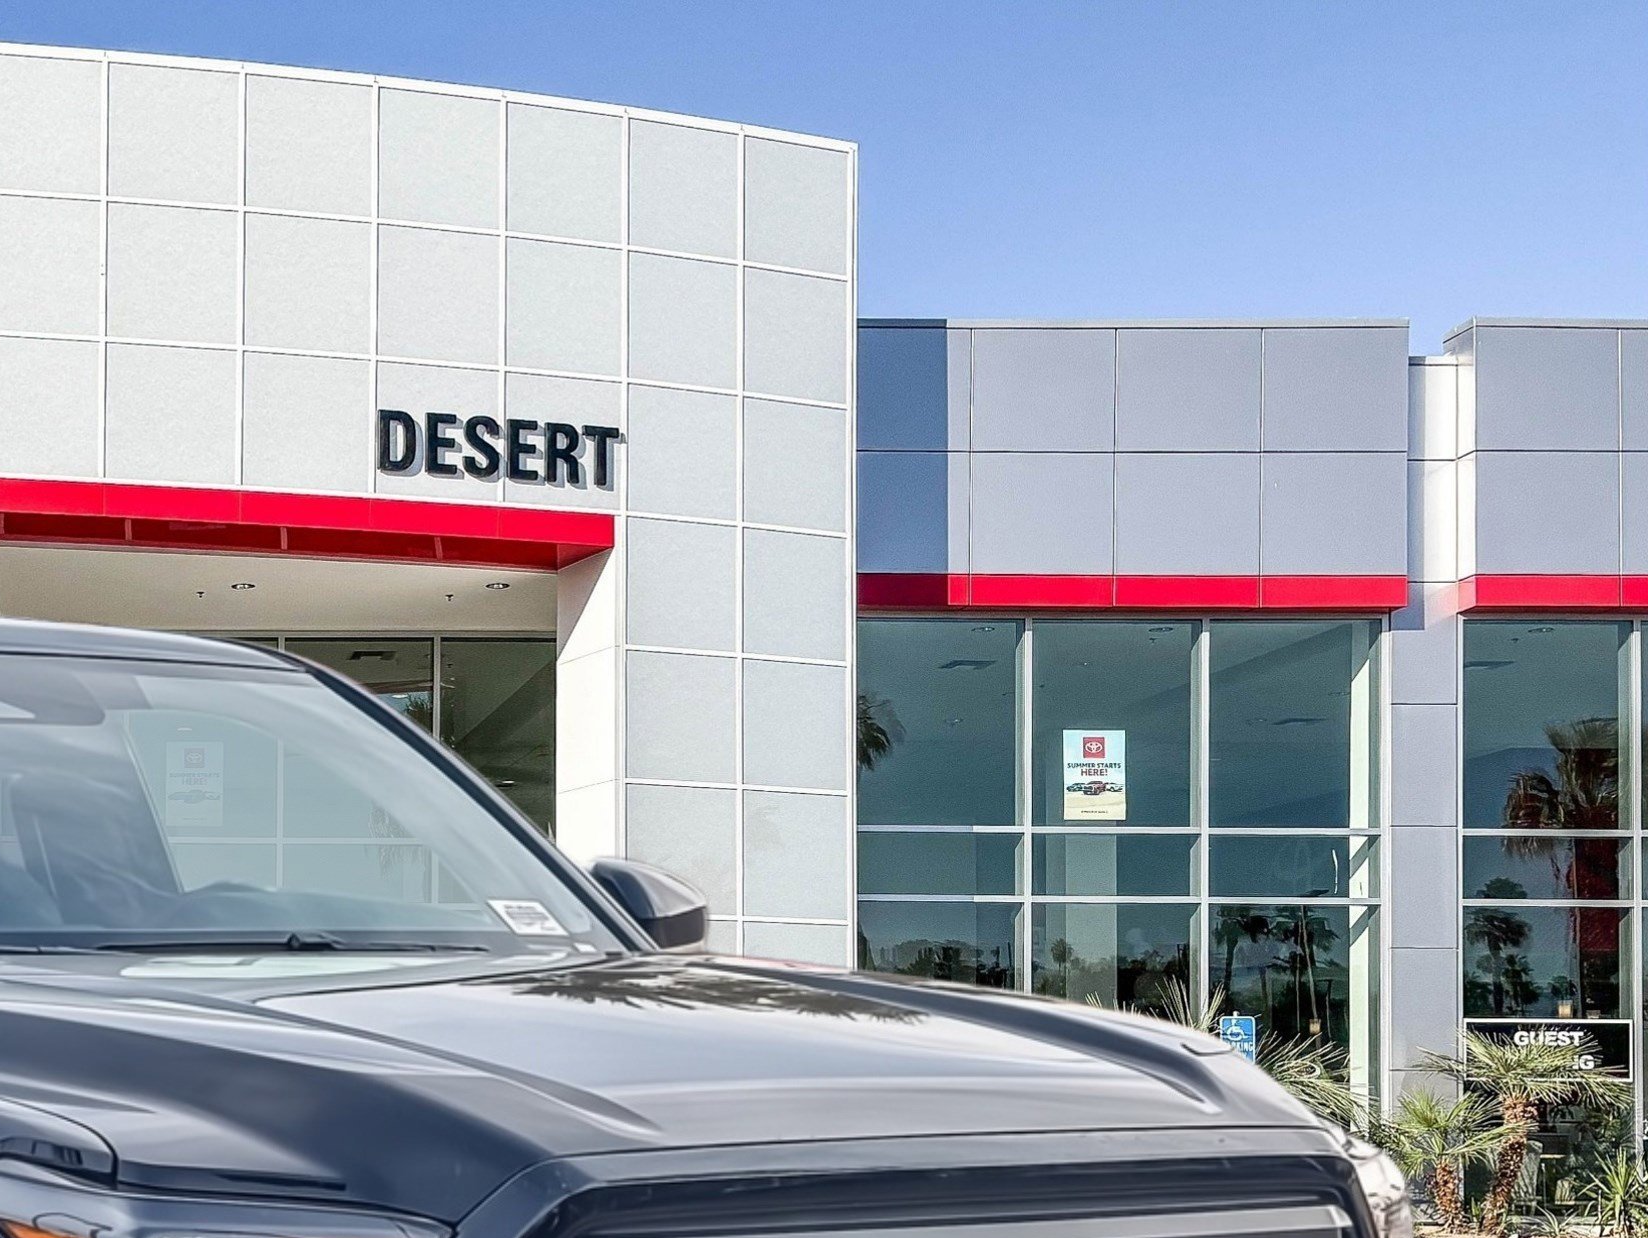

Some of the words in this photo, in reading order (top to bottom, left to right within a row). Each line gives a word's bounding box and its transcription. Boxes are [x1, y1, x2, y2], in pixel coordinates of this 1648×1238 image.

[377, 409, 620, 486] DESERT
[1081, 768, 1108, 777] HERE!
[1513, 1030, 1585, 1047] GUEST
